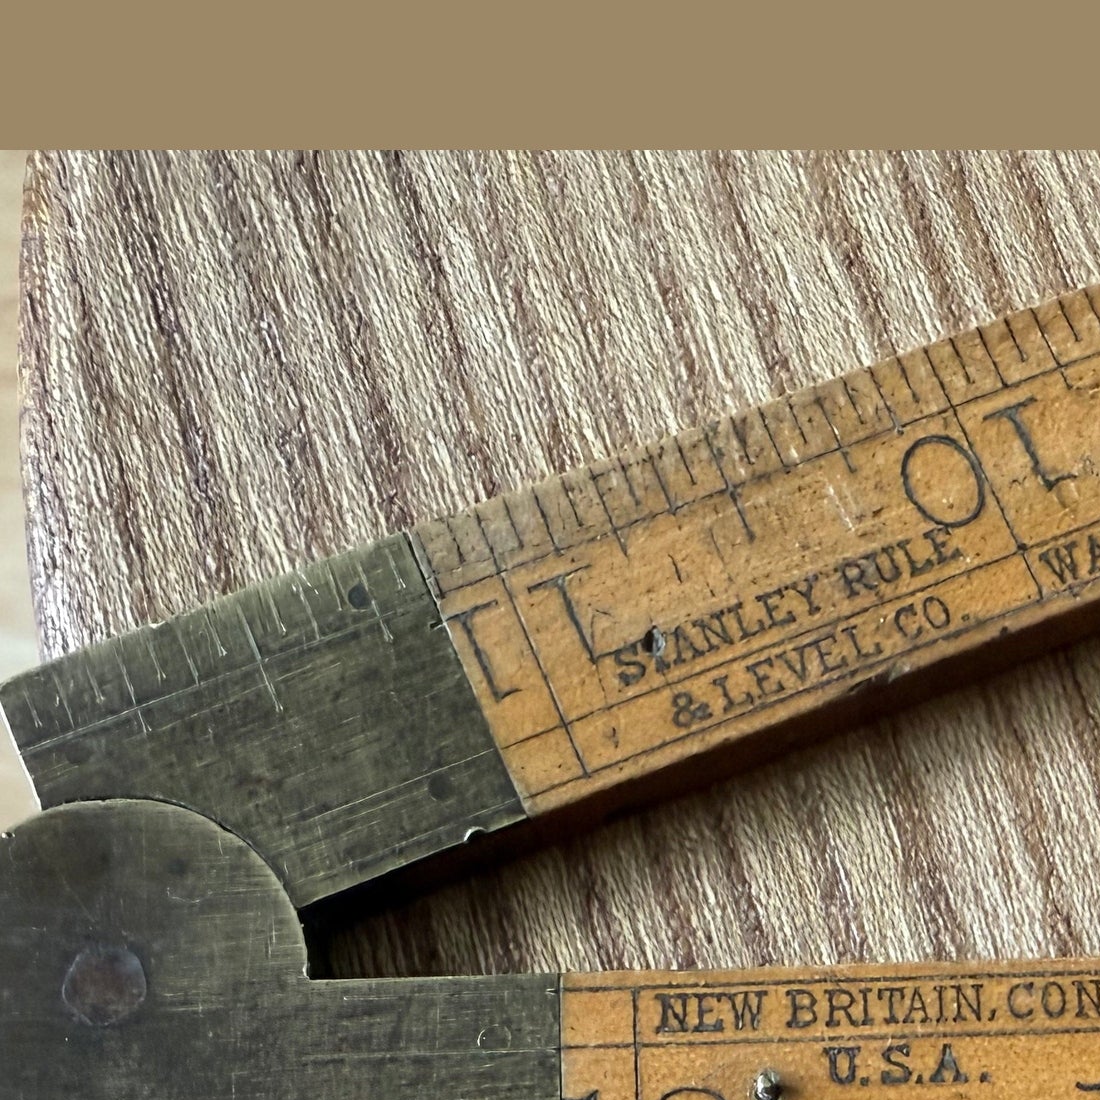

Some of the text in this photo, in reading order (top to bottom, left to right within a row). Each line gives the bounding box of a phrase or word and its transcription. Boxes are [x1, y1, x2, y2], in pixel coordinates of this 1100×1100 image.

[901, 395, 1078, 528] 10
[846, 526, 965, 599] RULE
[672, 595, 972, 728] & LEVEL CO.
[655, 991, 767, 1034] NEW
[823, 1043, 992, 1086] U.S.A.
